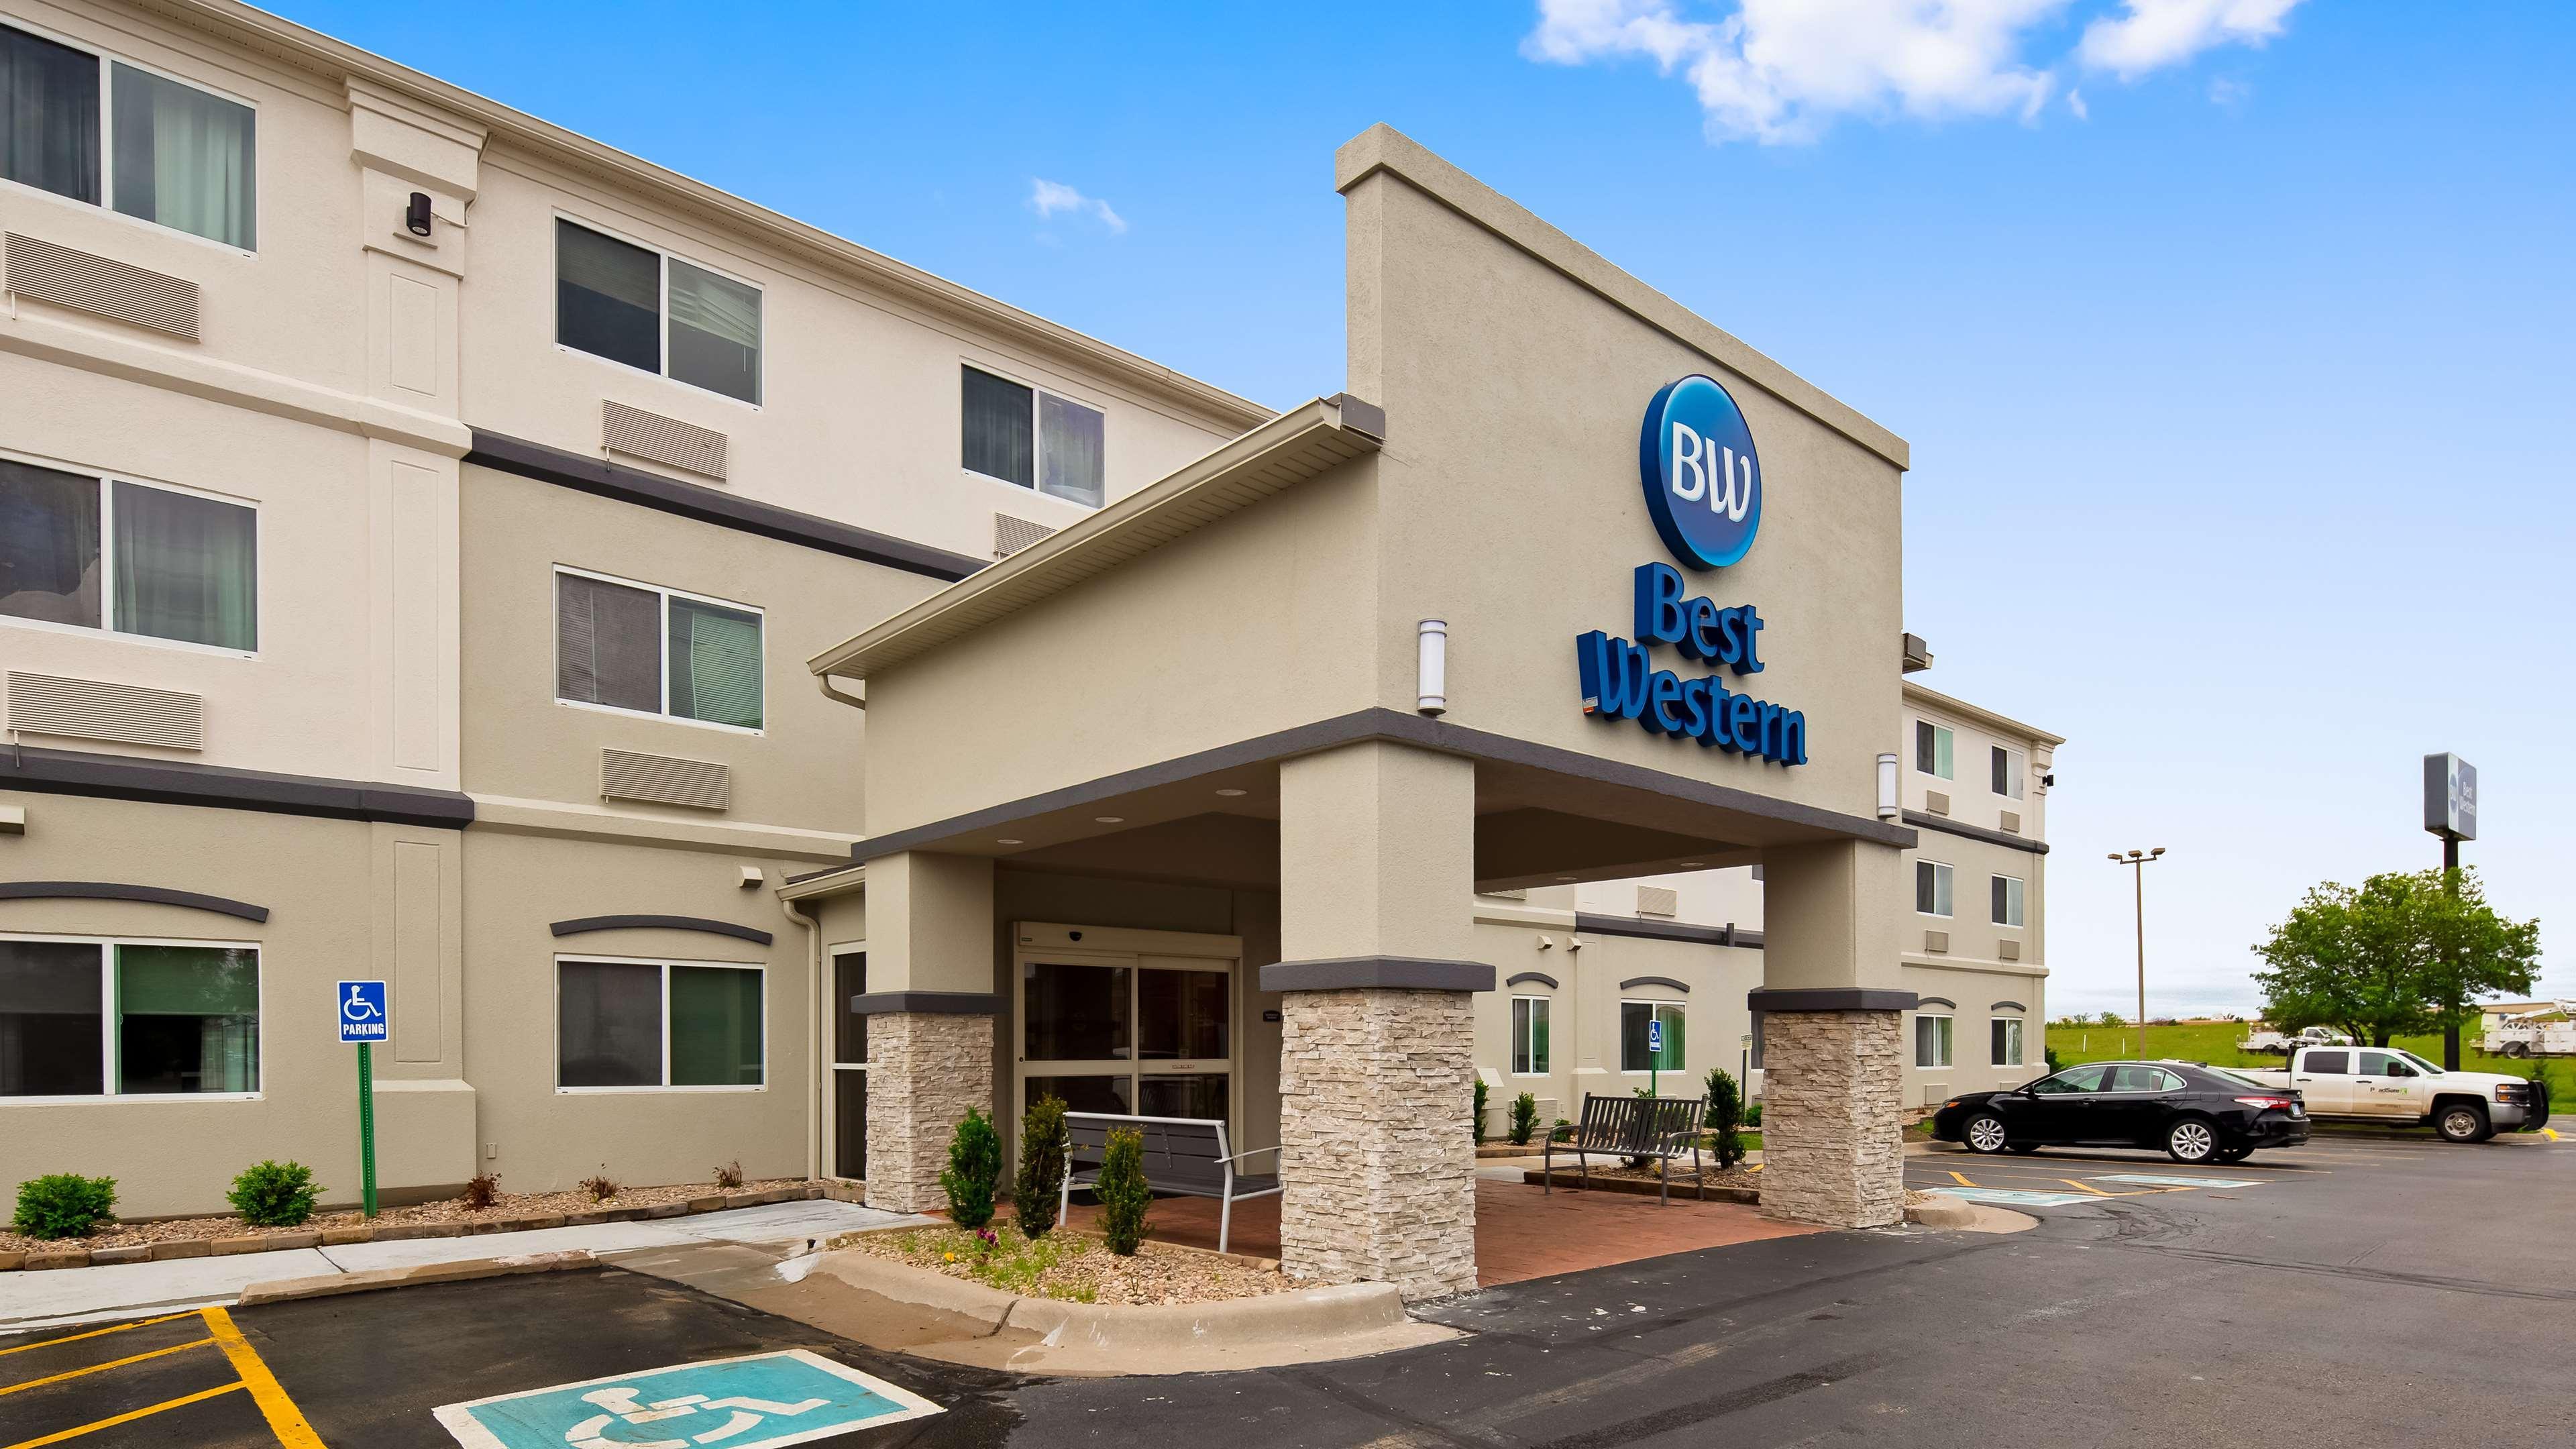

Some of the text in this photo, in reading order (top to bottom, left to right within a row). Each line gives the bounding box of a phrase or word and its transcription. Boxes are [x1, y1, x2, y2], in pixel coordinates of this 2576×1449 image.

[1672, 421, 1752, 523] BW
[1635, 561, 1765, 676] Best
[1576, 629, 1808, 767] Western
[343, 1023, 384, 1035] PARKING
